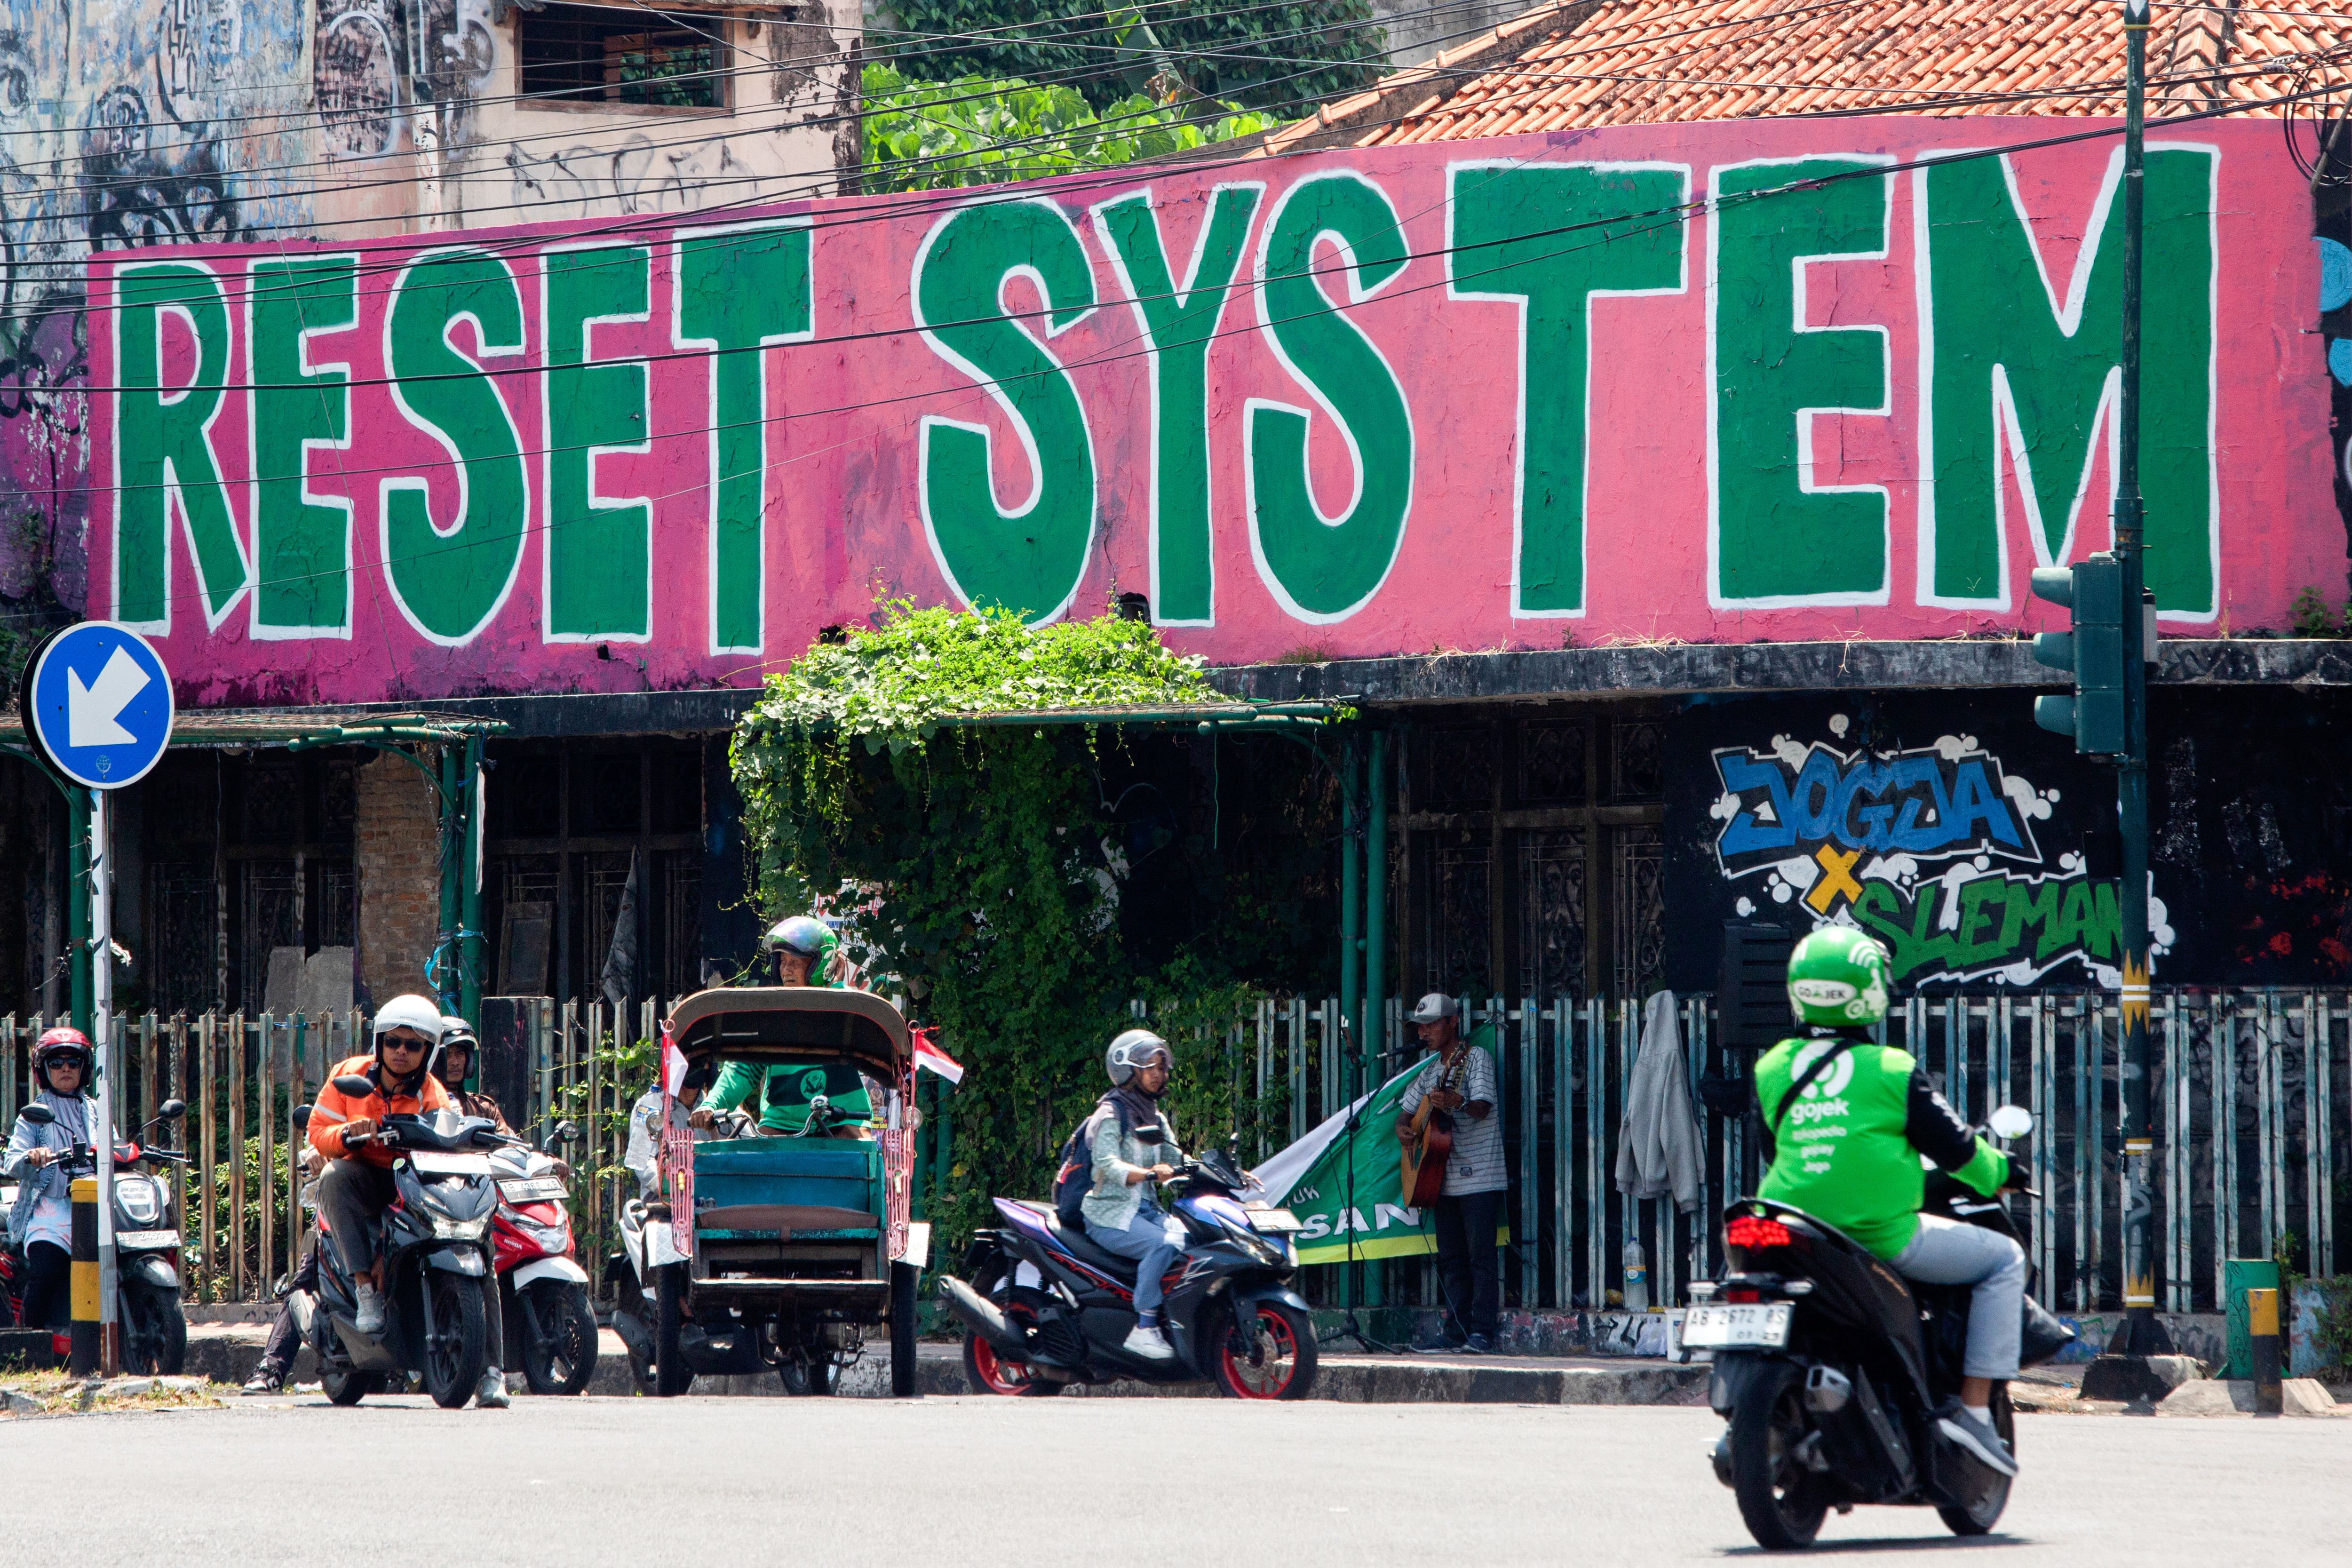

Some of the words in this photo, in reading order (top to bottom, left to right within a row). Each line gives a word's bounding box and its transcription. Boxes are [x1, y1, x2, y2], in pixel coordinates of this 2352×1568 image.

[110, 215, 815, 656] RESET
[911, 141, 2220, 628] SYSTEM
[1720, 750, 2024, 857] JOGJA
[1851, 877, 2123, 980] SLEMAN
[1790, 1098, 1850, 1125] gojek
[503, 1183, 516, 1193] AB
[118, 1233, 130, 1242] AB
[504, 1238, 523, 1250] HONDA
[1691, 1310, 1708, 1325] AB
